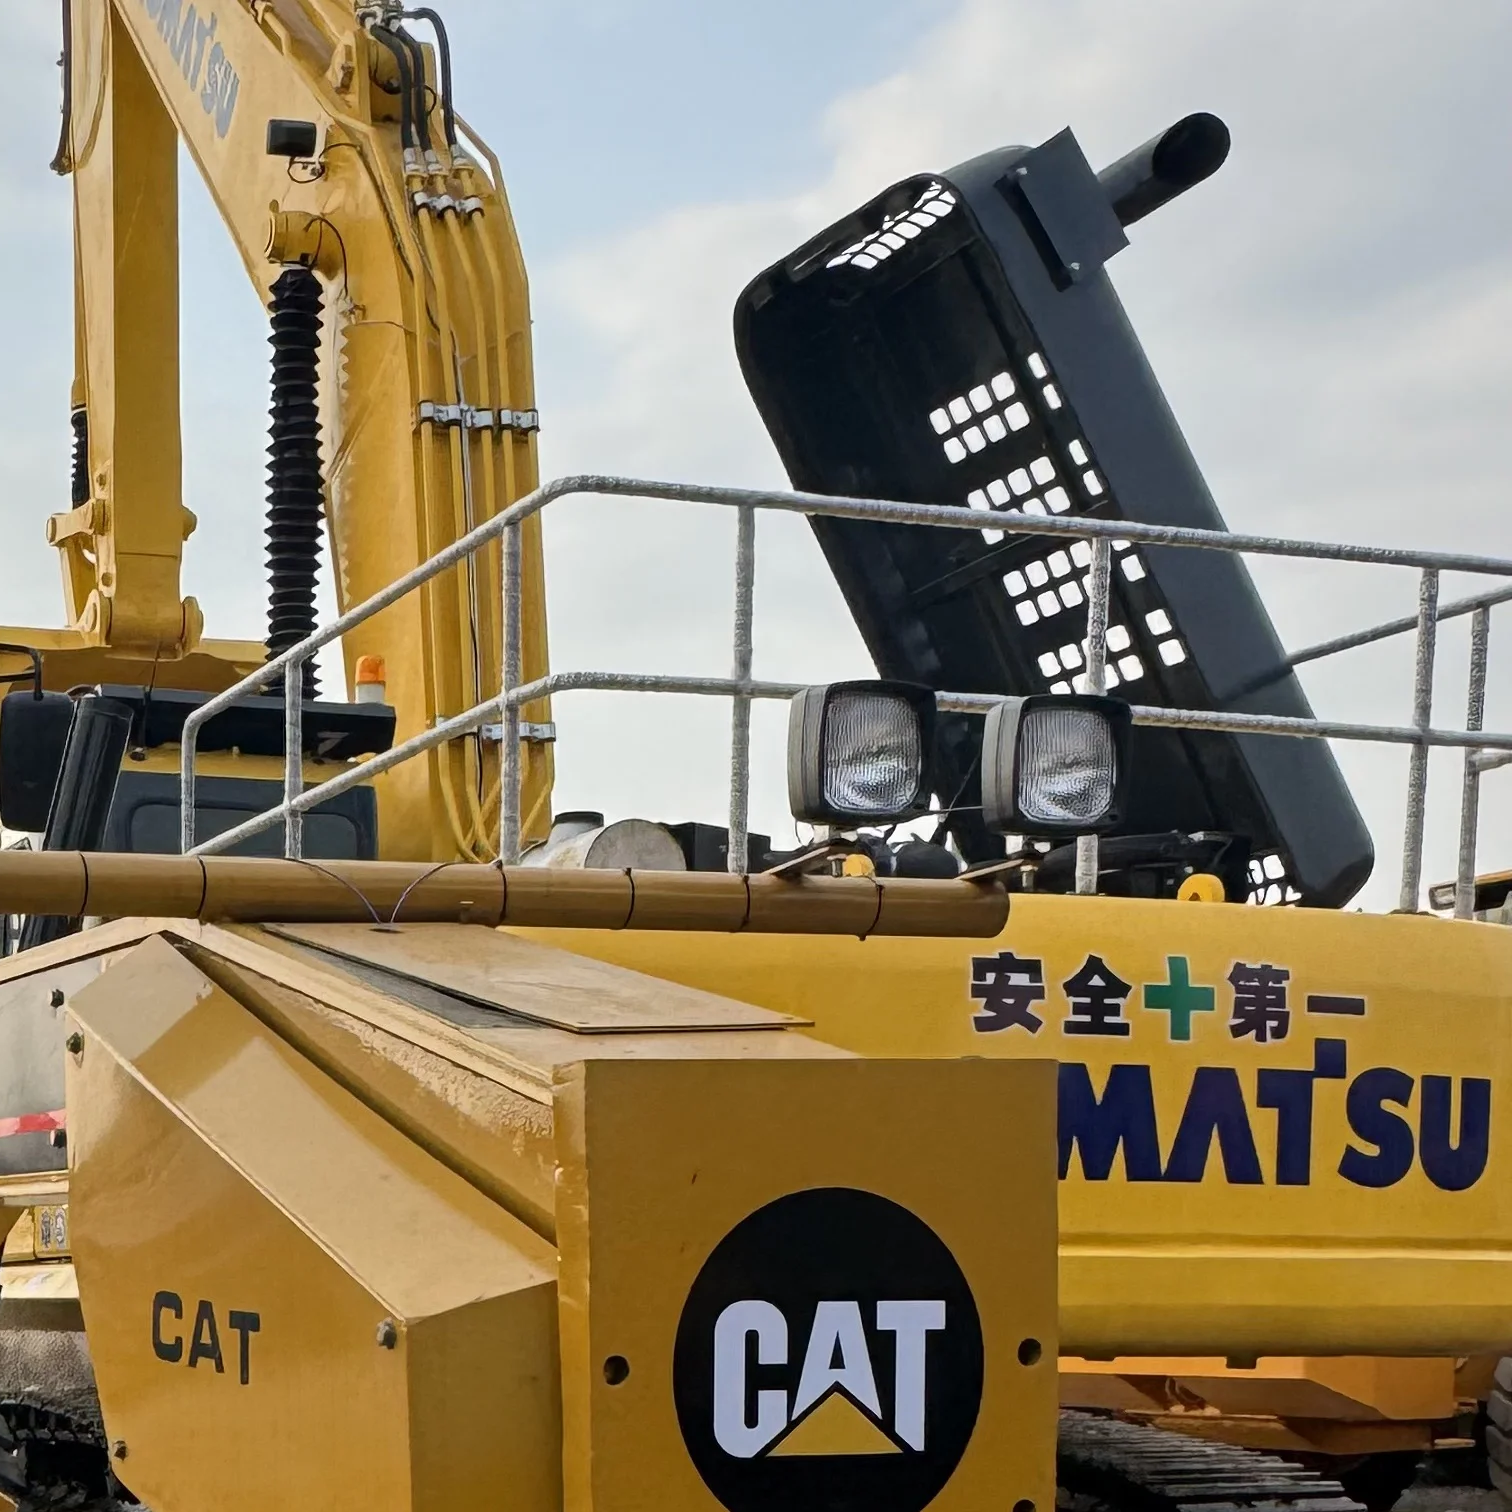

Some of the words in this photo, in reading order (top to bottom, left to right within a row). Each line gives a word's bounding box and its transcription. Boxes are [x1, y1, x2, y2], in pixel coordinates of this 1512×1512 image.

[141, 0, 240, 138] MATSU
[1058, 1037, 1491, 1192] MATSU
[152, 1290, 261, 1386] CAT
[713, 1299, 947, 1459] CAT
